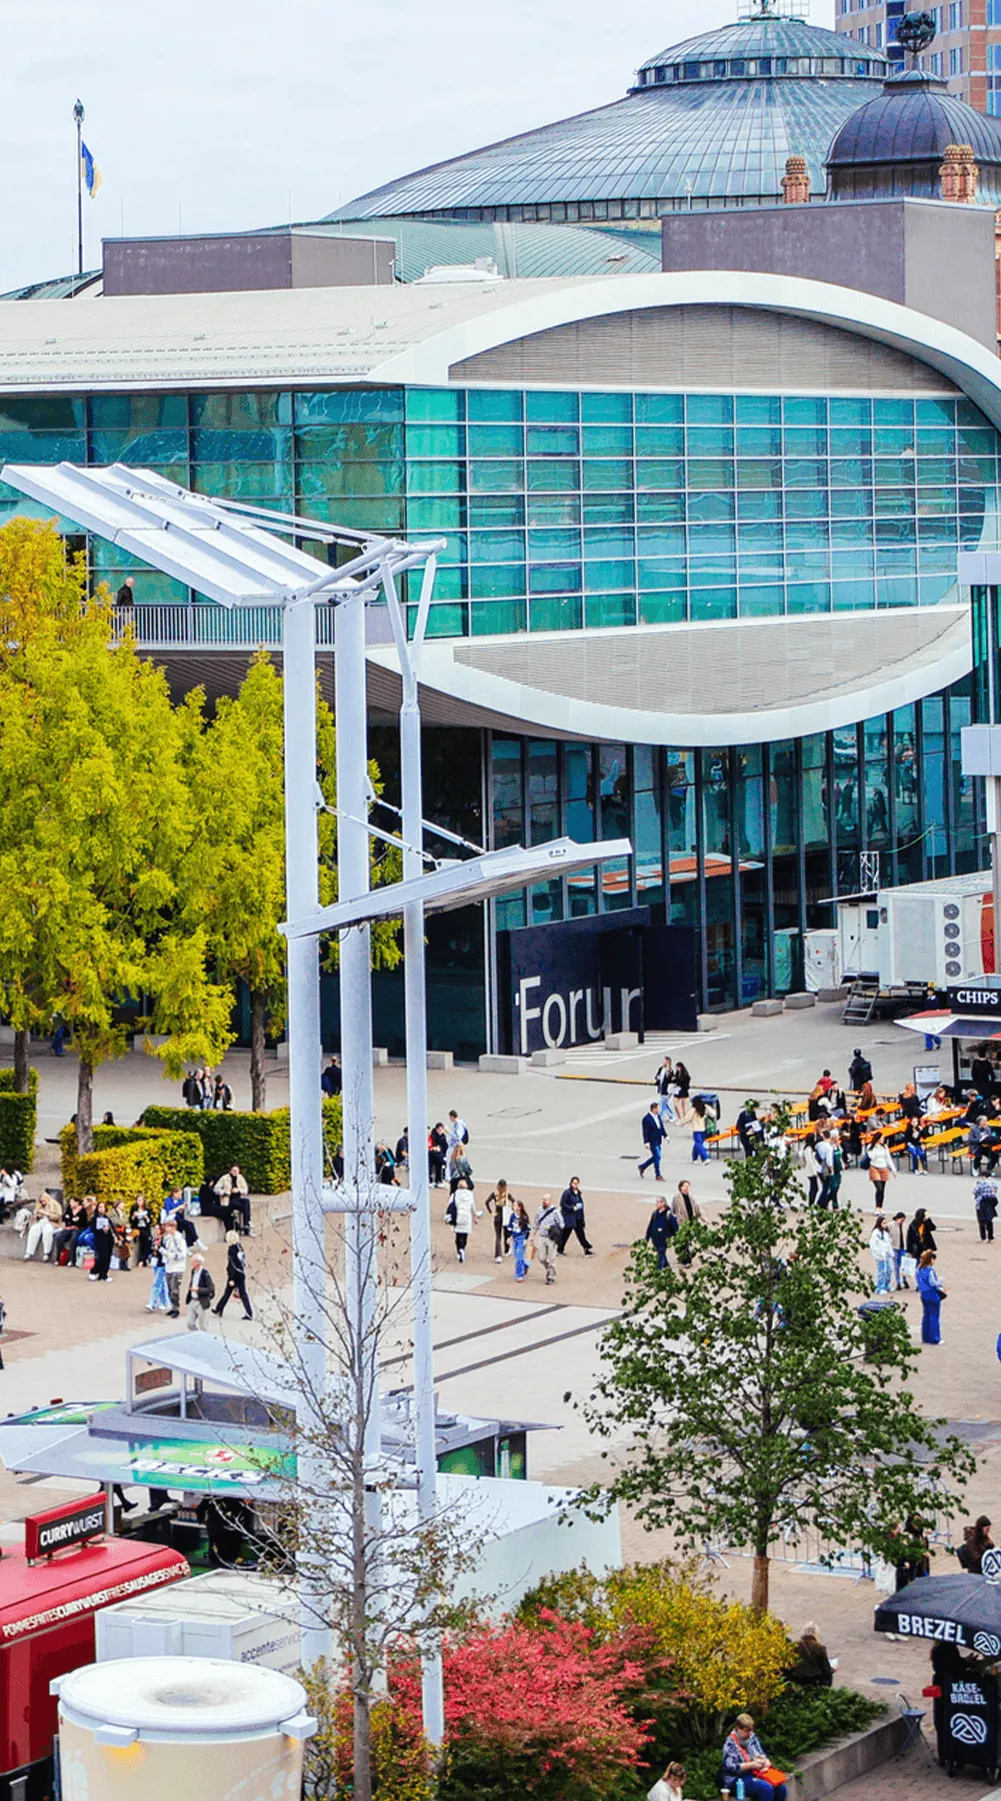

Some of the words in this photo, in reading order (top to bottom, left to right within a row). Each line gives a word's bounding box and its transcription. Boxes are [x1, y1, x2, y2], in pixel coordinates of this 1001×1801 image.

[957, 991, 998, 1004] CHIPS
[40, 1511, 104, 1546] CURRYWURST
[897, 1614, 967, 1645] BREZEL
[952, 1681, 982, 1693] KÄSE-
